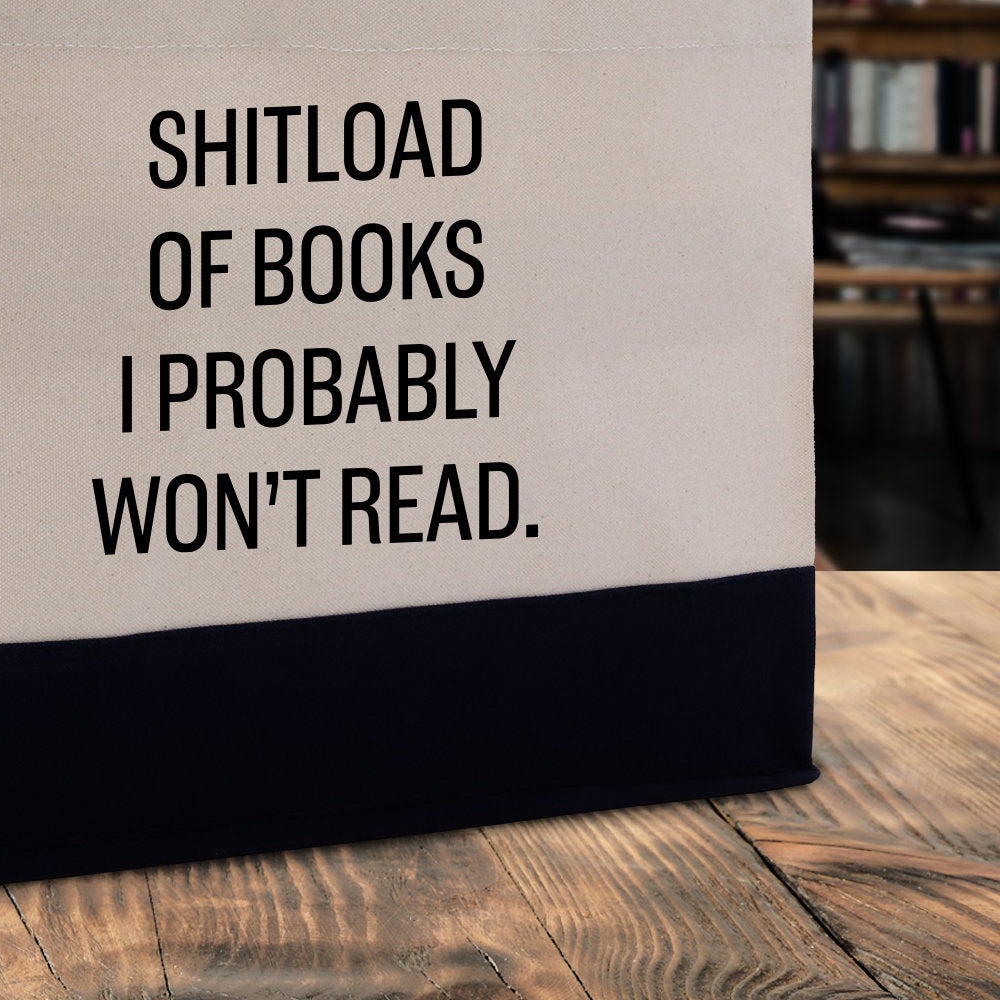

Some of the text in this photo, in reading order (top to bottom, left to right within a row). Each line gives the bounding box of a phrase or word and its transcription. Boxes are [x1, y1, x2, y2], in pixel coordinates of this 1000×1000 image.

[148, 98, 483, 190] SHITLOAD
[149, 218, 485, 311] OF BOOKS
[121, 339, 517, 434] I PROBABLY
[91, 461, 540, 556] WON’T READ.
